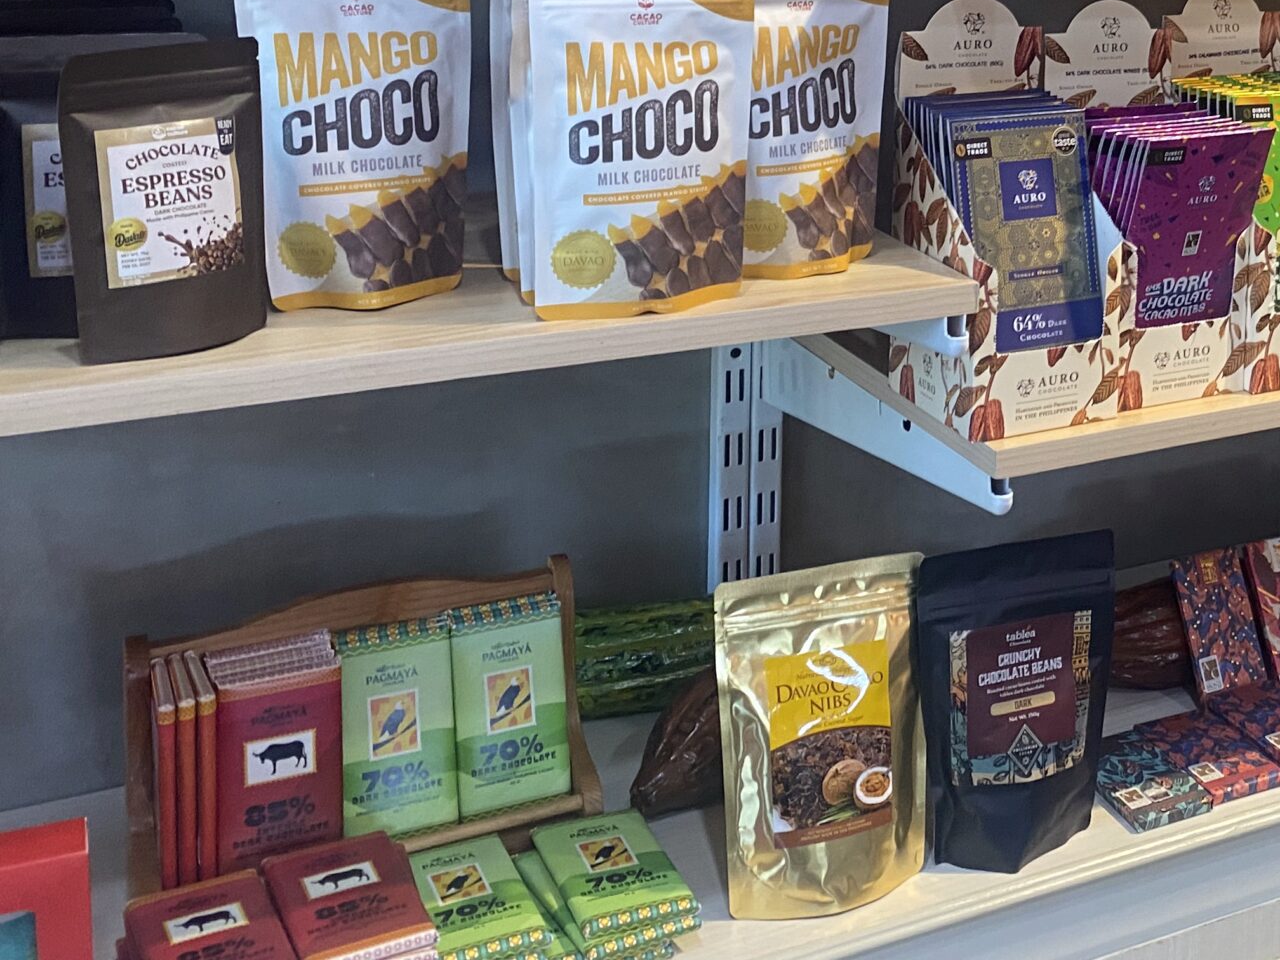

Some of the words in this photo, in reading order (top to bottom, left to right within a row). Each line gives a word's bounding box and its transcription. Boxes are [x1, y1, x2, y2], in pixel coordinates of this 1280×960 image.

[340, 3, 374, 12] CACAO
[630, 13, 662, 22] CACAO
[1207, 23, 1240, 33] AURO
[953, 39, 992, 51] AURO
[1093, 43, 1128, 54] AURO
[752, 23, 860, 92] MANGO
[273, 31, 438, 108] MANGO
[565, 39, 718, 116] MANGO
[749, 57, 856, 139] CHOCO
[282, 69, 440, 156] CHOCO
[568, 79, 720, 166] CHOCO
[217, 119, 232, 128] READY
[220, 134, 233, 146] EAT
[768, 144, 798, 159] MILK
[800, 135, 847, 154] CHOCOLATE
[1053, 137, 1077, 147] taste
[125, 143, 220, 170] CHOCOLATE
[312, 161, 346, 176] MILK
[351, 154, 423, 174] CHOCOLATE
[120, 165, 226, 194] ESPRESSO
[597, 171, 630, 187] MILK
[634, 164, 701, 184] CHOCOLATE
[144, 185, 213, 209] BEANS
[631, 191, 661, 200] COVERED
[1013, 191, 1046, 204] AURO
[1187, 194, 1218, 205] AURO
[154, 208, 171, 216] DARK
[172, 202, 207, 213] CHOCOLATE
[563, 256, 605, 267] DAVAO
[1162, 271, 1212, 295] DARK
[1138, 289, 1213, 312] CHOCOLATE
[1013, 313, 1046, 332] 64%
[1144, 306, 1178, 321] CACAO
[1173, 345, 1211, 360] AURO
[1173, 357, 1210, 368] CHOCOLATE
[1038, 371, 1079, 388] AURO
[1038, 383, 1078, 395] CHOCOLATE
[1024, 411, 1037, 420] THE
[1039, 406, 1078, 418] PHILIPPINES
[998, 647, 1041, 667] CRUNCHY
[978, 664, 1030, 687] CHOCOLATE
[1031, 656, 1063, 674] BEANS
[810, 693, 851, 715] NIBS
[1014, 698, 1032, 710] DARK
[479, 734, 544, 766] 70%
[361, 761, 430, 792] 70%
[244, 794, 315, 828] 85%
[585, 867, 653, 889] 70%
[315, 894, 389, 921] 85%
[433, 897, 506, 923] 70%
